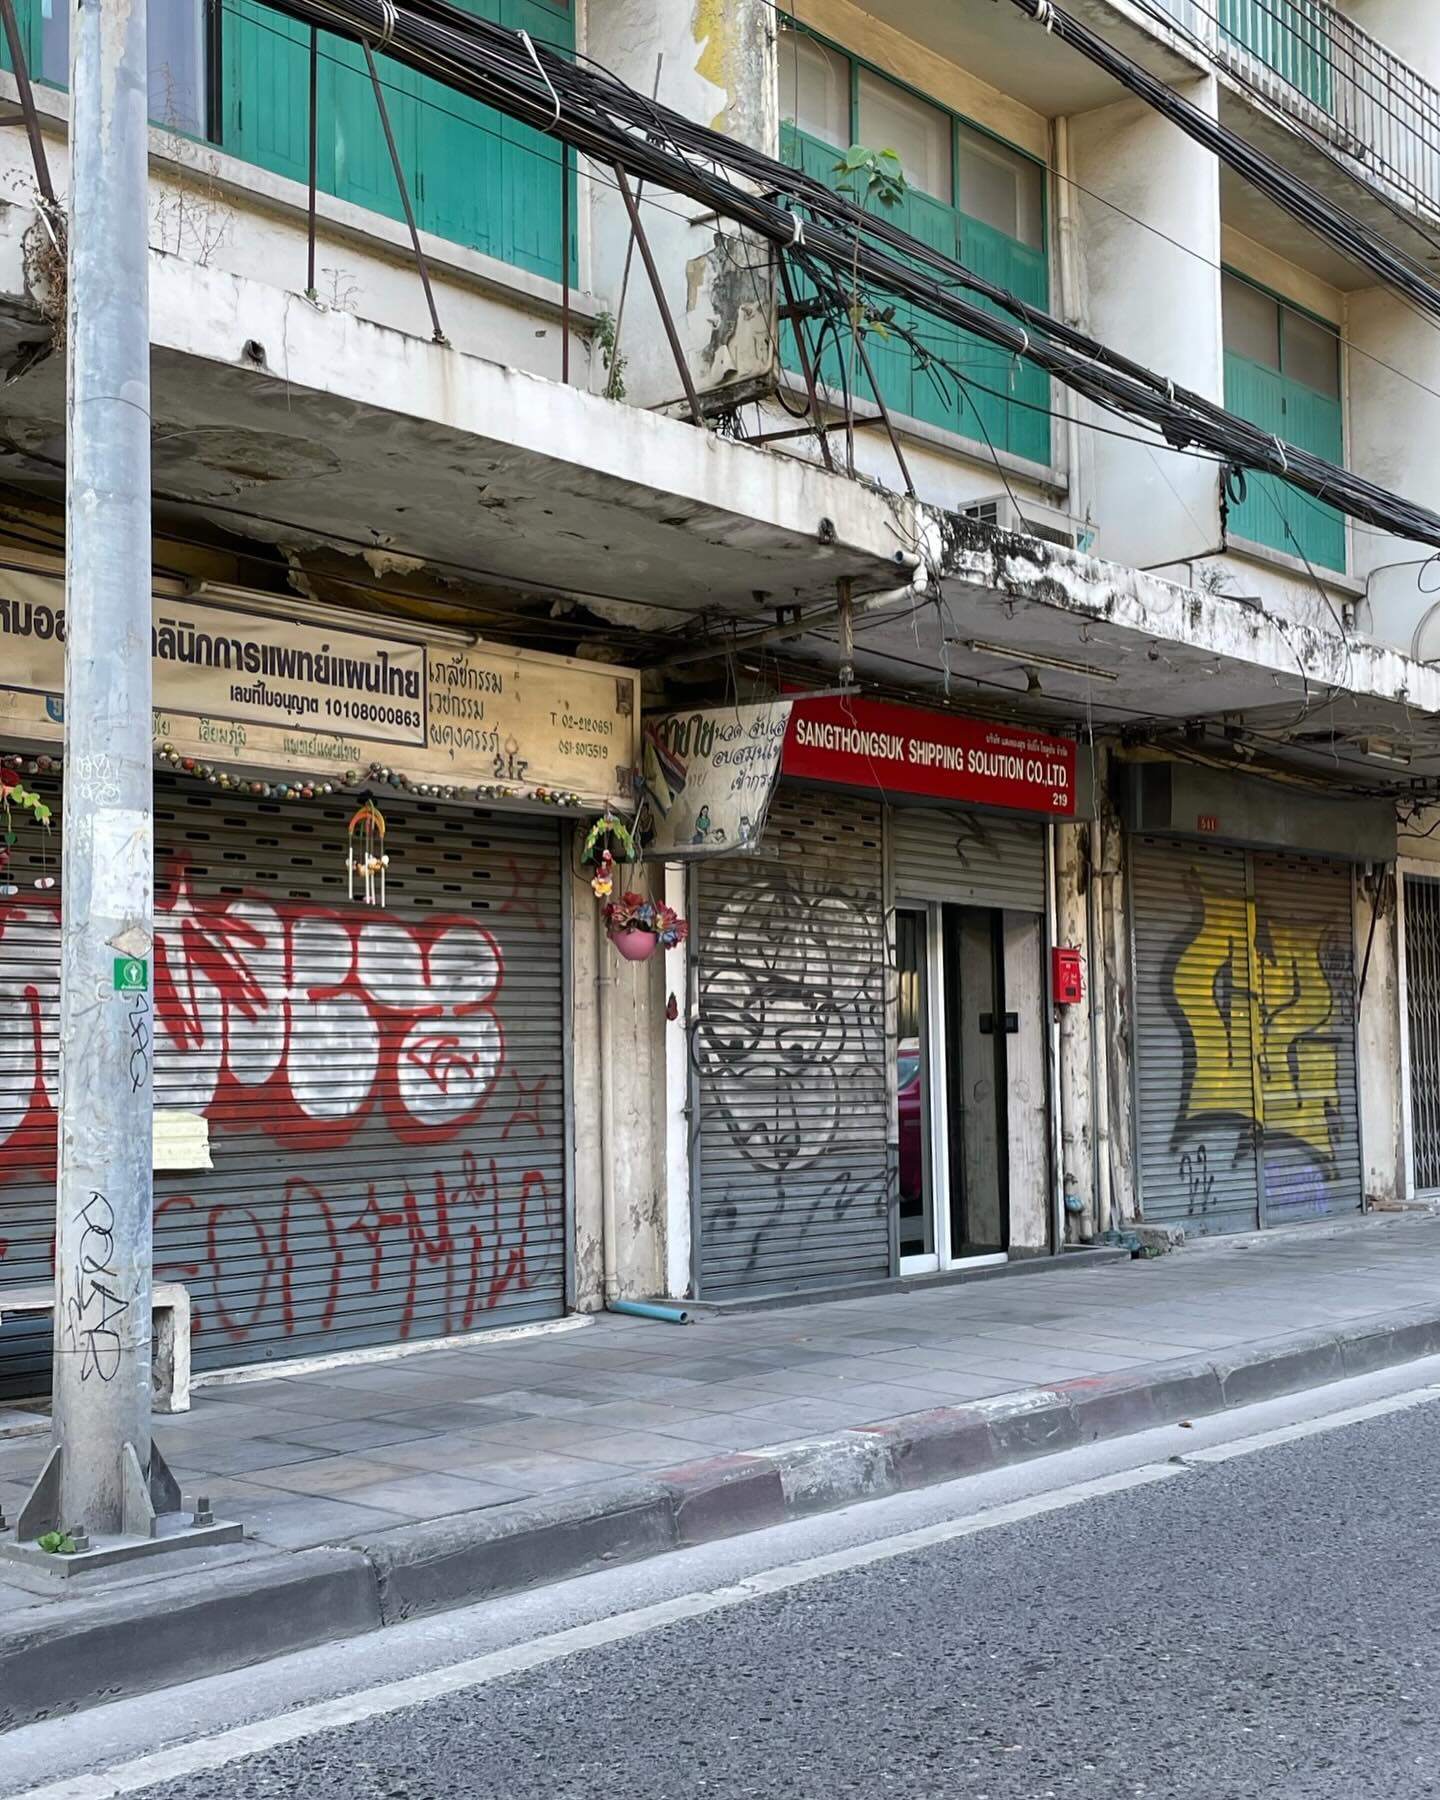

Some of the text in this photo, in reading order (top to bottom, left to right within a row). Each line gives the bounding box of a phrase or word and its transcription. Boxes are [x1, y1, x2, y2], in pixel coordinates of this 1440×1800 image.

[230, 680, 421, 728] เลขที่ใบอนุญาต 10108000863
[429, 687, 485, 721] เวชกรรม
[796, 718, 1069, 788] SANGTHONGSUK SHIPPING SOLUTION CO.,LTD.
[1052, 792, 1068, 807] 219
